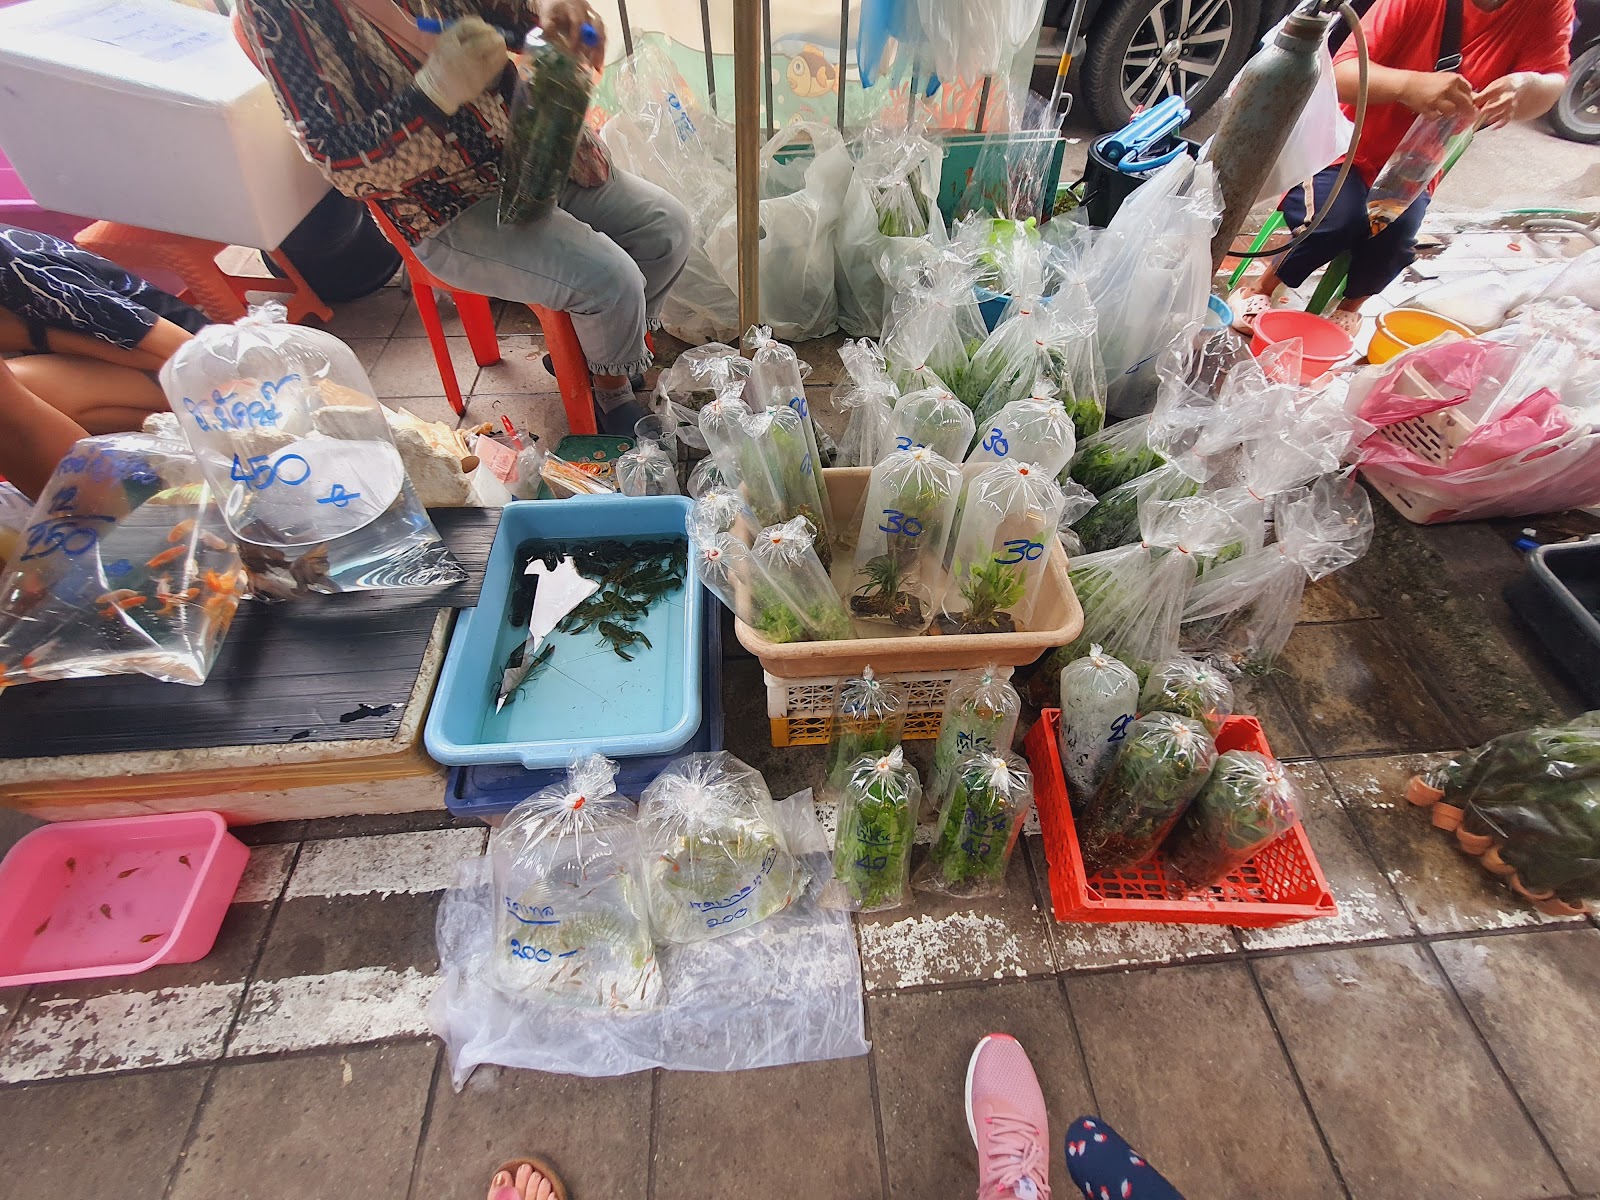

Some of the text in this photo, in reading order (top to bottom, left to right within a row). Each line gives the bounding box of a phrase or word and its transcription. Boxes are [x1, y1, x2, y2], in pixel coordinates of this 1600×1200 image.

[983, 427, 1009, 456] 30
[230, 452, 311, 490] 450
[879, 509, 923, 537] 30
[994, 539, 1044, 564] 30
[706, 907, 748, 928] 200
